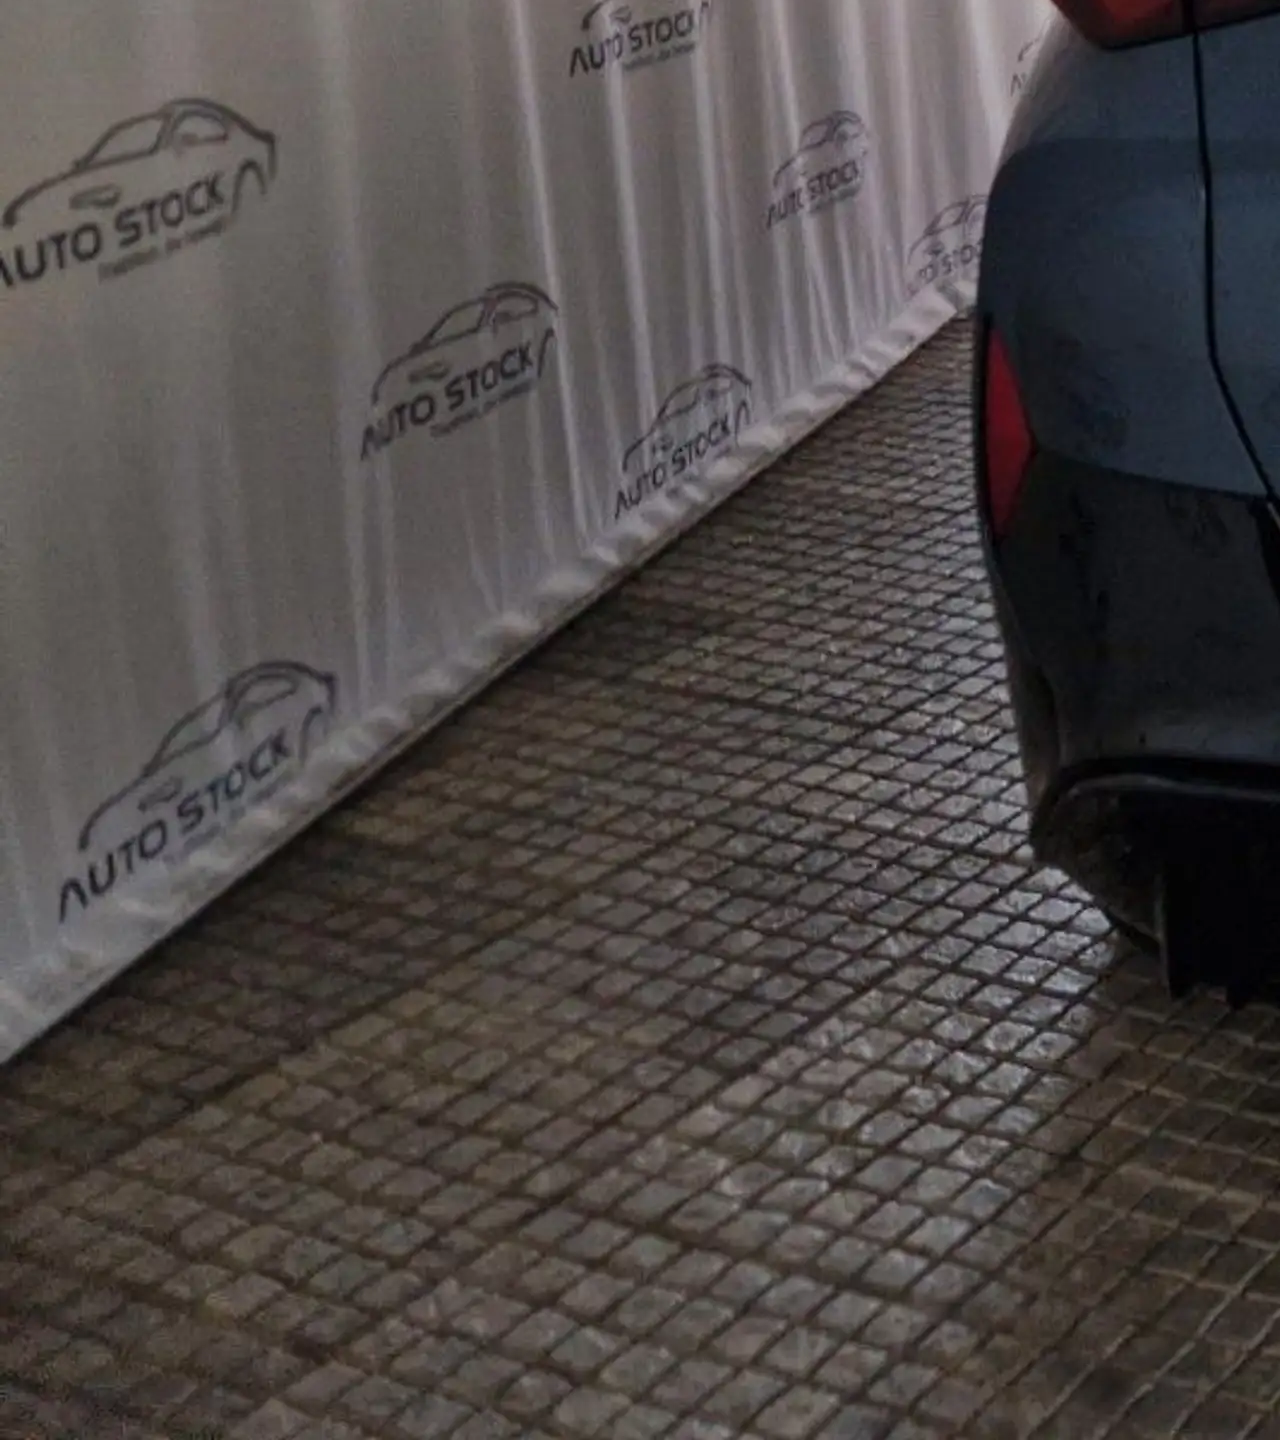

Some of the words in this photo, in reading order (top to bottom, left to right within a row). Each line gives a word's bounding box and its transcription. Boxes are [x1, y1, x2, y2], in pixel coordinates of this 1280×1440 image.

[114, 171, 227, 251] STOCK
[360, 394, 436, 460] AUTO
[444, 342, 534, 415] STOCK
[614, 464, 666, 521] AUTO
[671, 416, 731, 475] STOCK
[58, 820, 168, 924] AUTO
[176, 727, 291, 838] STOCK
